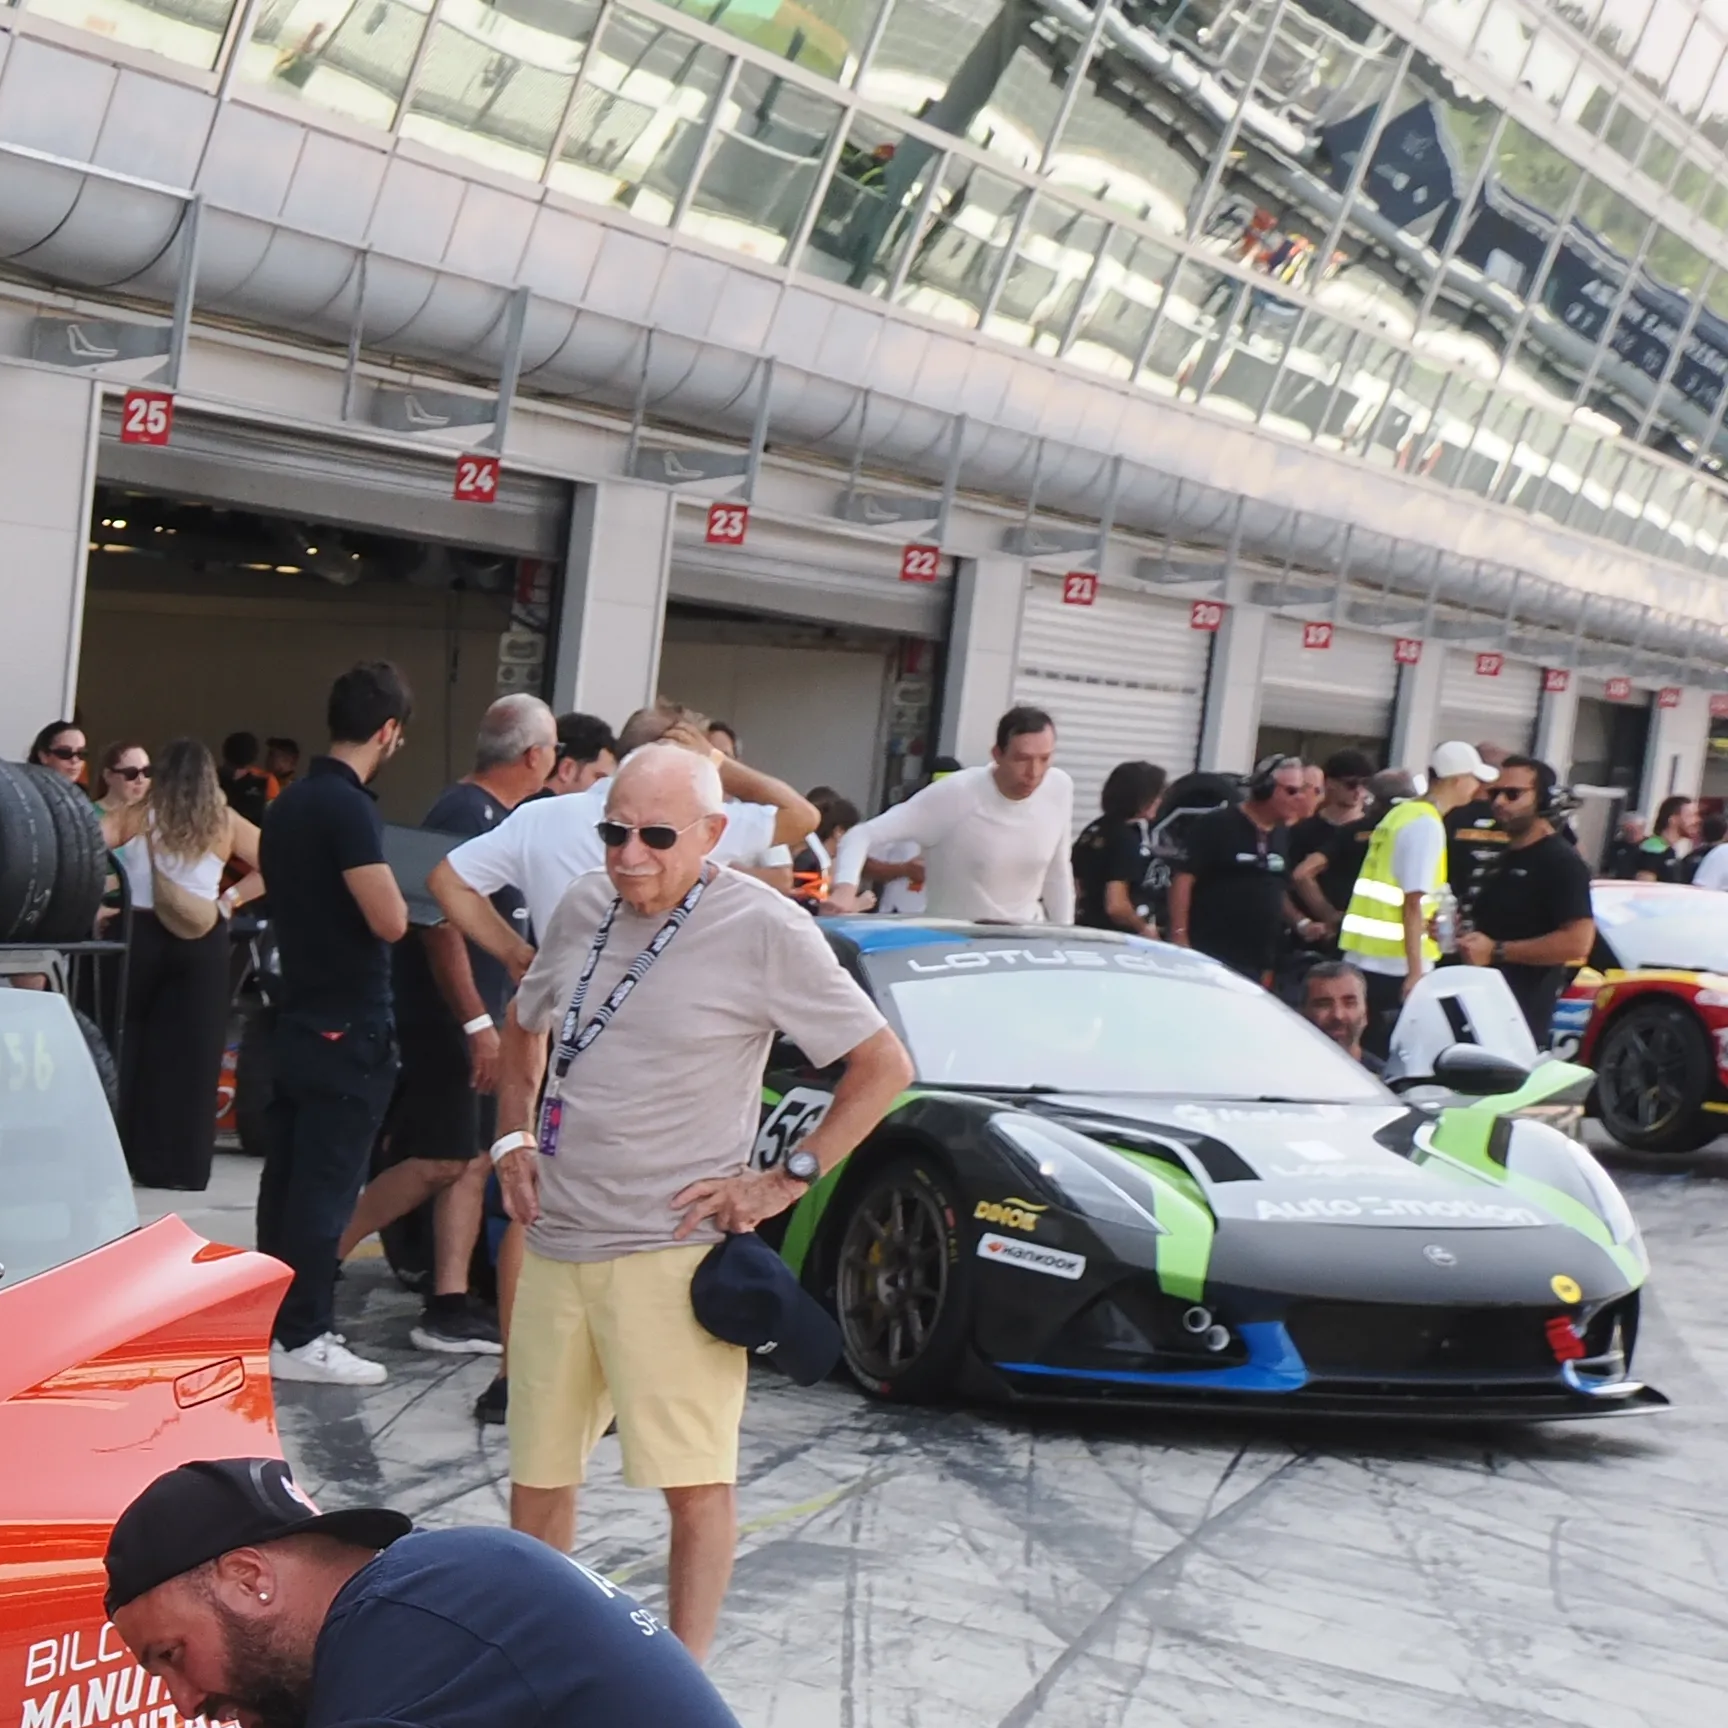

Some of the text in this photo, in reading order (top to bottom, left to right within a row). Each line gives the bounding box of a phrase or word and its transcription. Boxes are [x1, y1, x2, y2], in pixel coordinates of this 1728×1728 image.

[127, 398, 167, 434] 25
[460, 462, 495, 494] 24
[712, 509, 743, 539] 23
[906, 550, 936, 575] 22
[1066, 578, 1091, 600] 21
[1193, 606, 1221, 625] 20
[908, 950, 1107, 972] LOTUS
[25, 1621, 132, 1687] BILC
